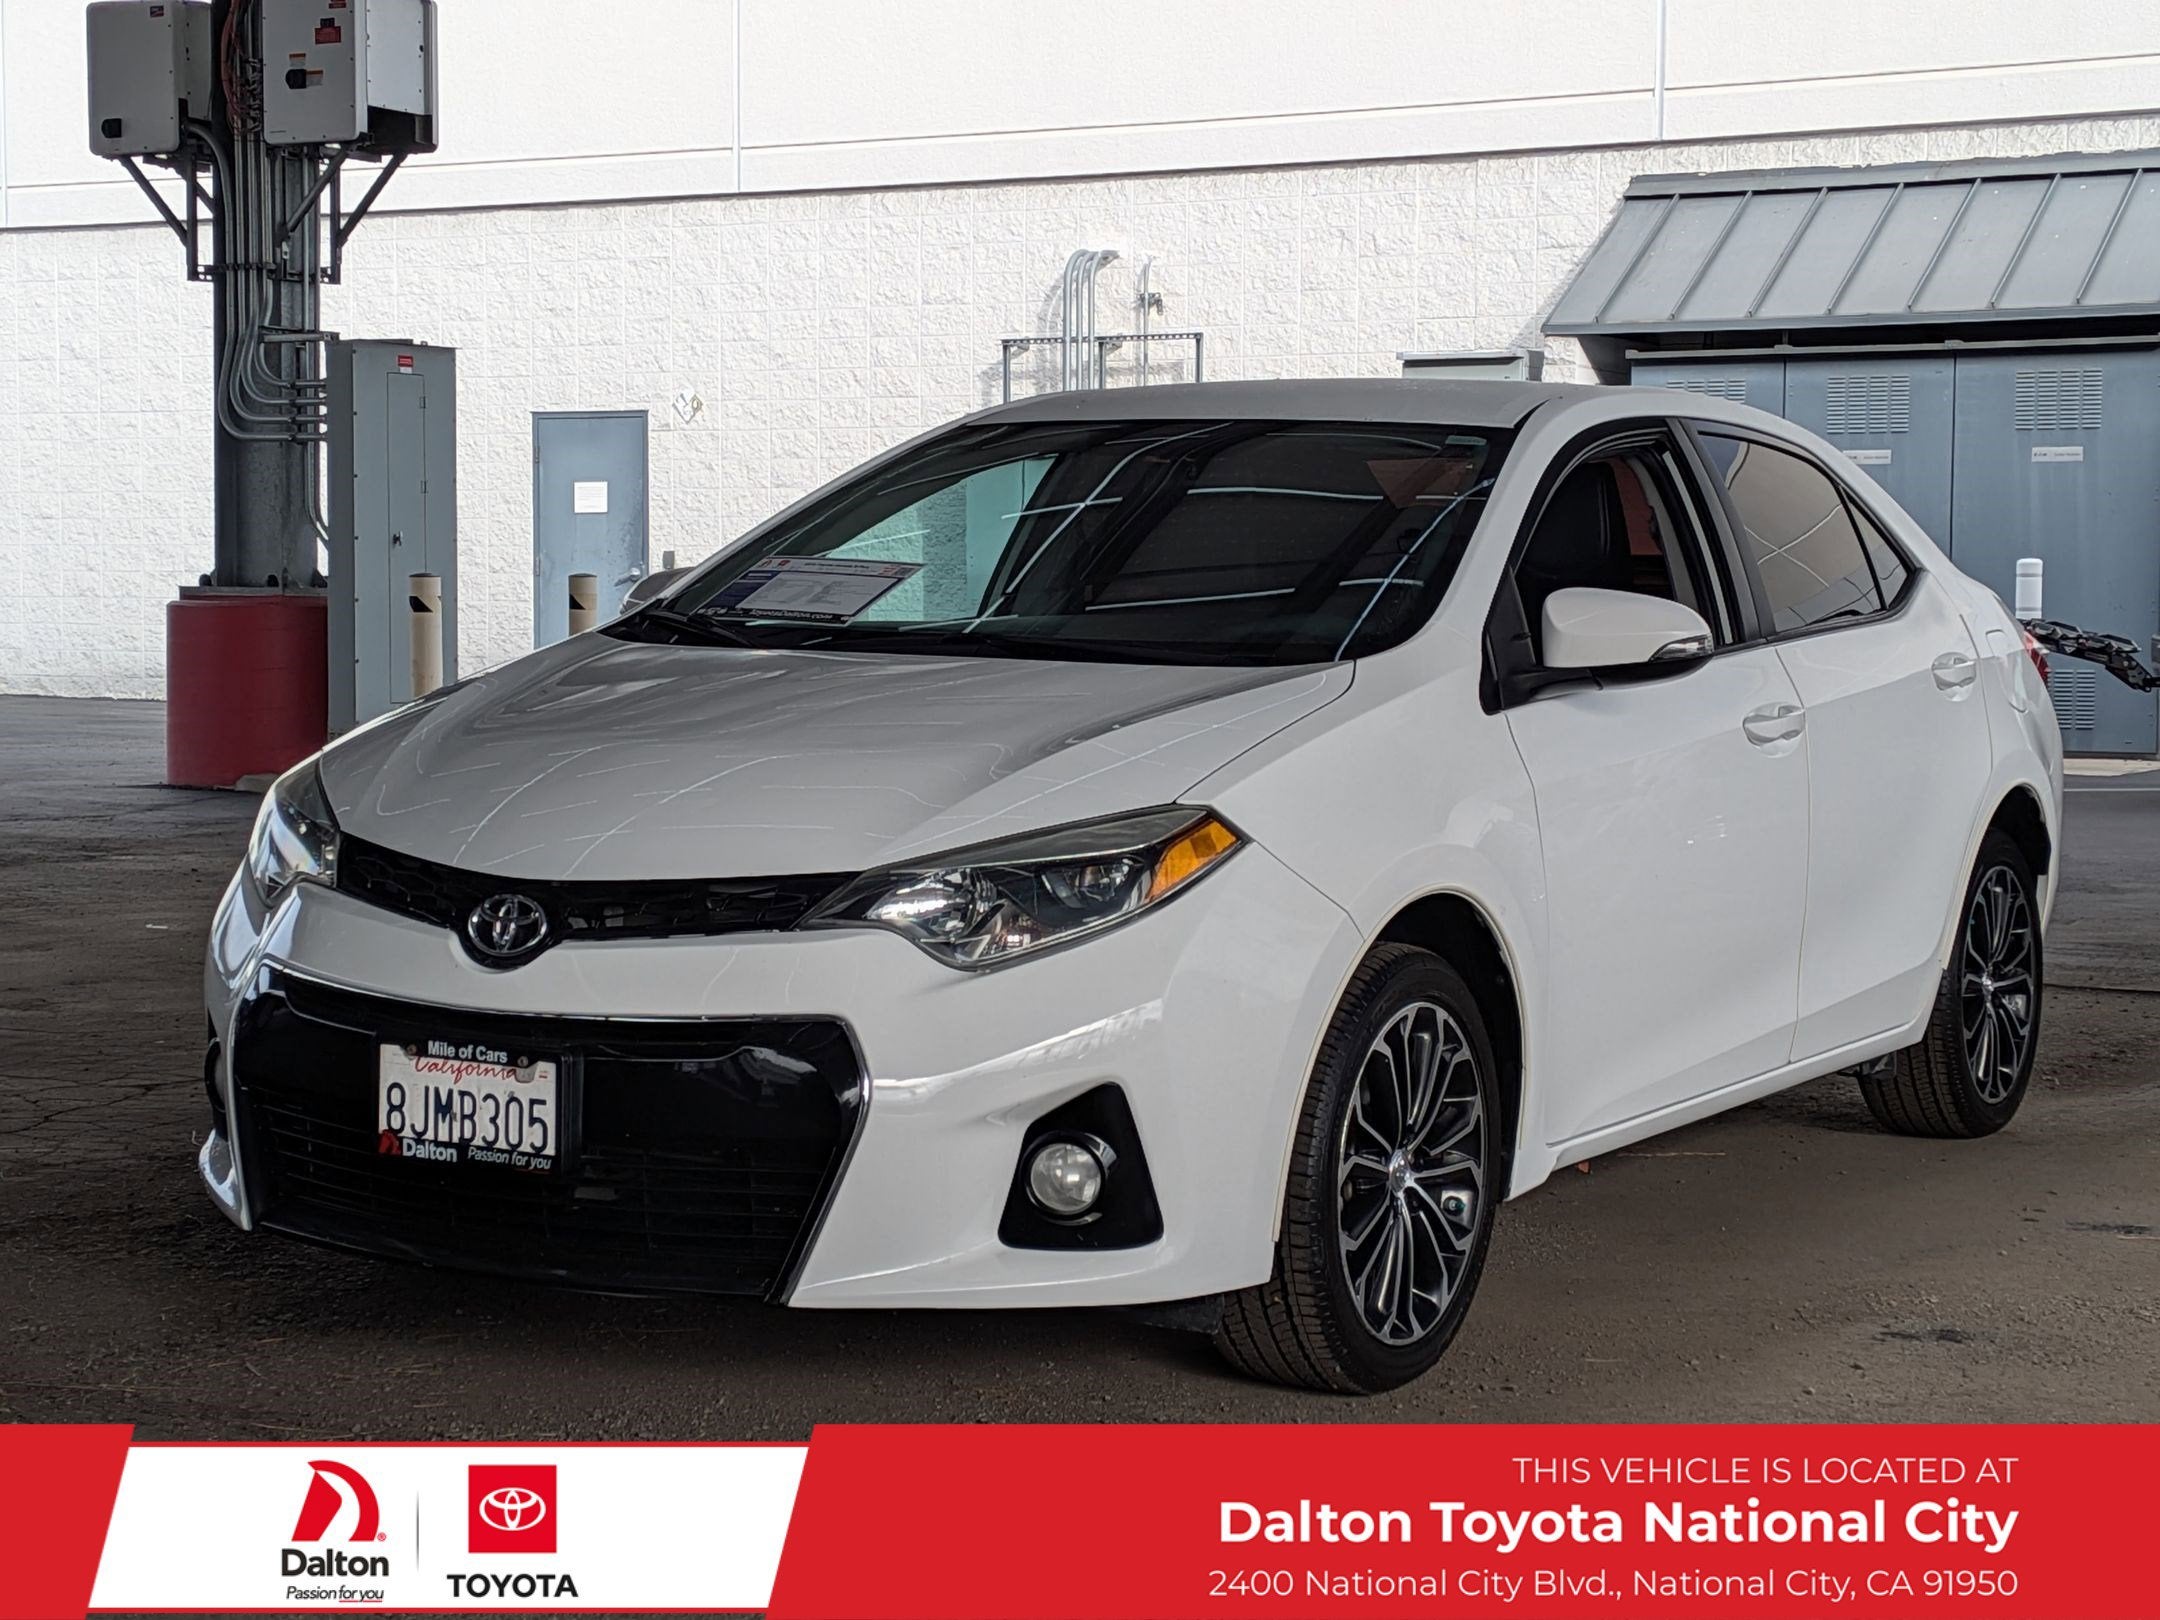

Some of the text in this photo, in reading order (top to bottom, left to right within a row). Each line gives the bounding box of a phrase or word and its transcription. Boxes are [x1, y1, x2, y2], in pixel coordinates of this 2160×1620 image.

[428, 1040, 508, 1064] Mile of Cars
[386, 1082, 549, 1155] 8JMB305
[402, 1139, 458, 1163] Dalton
[467, 1147, 552, 1170] Passion for you
